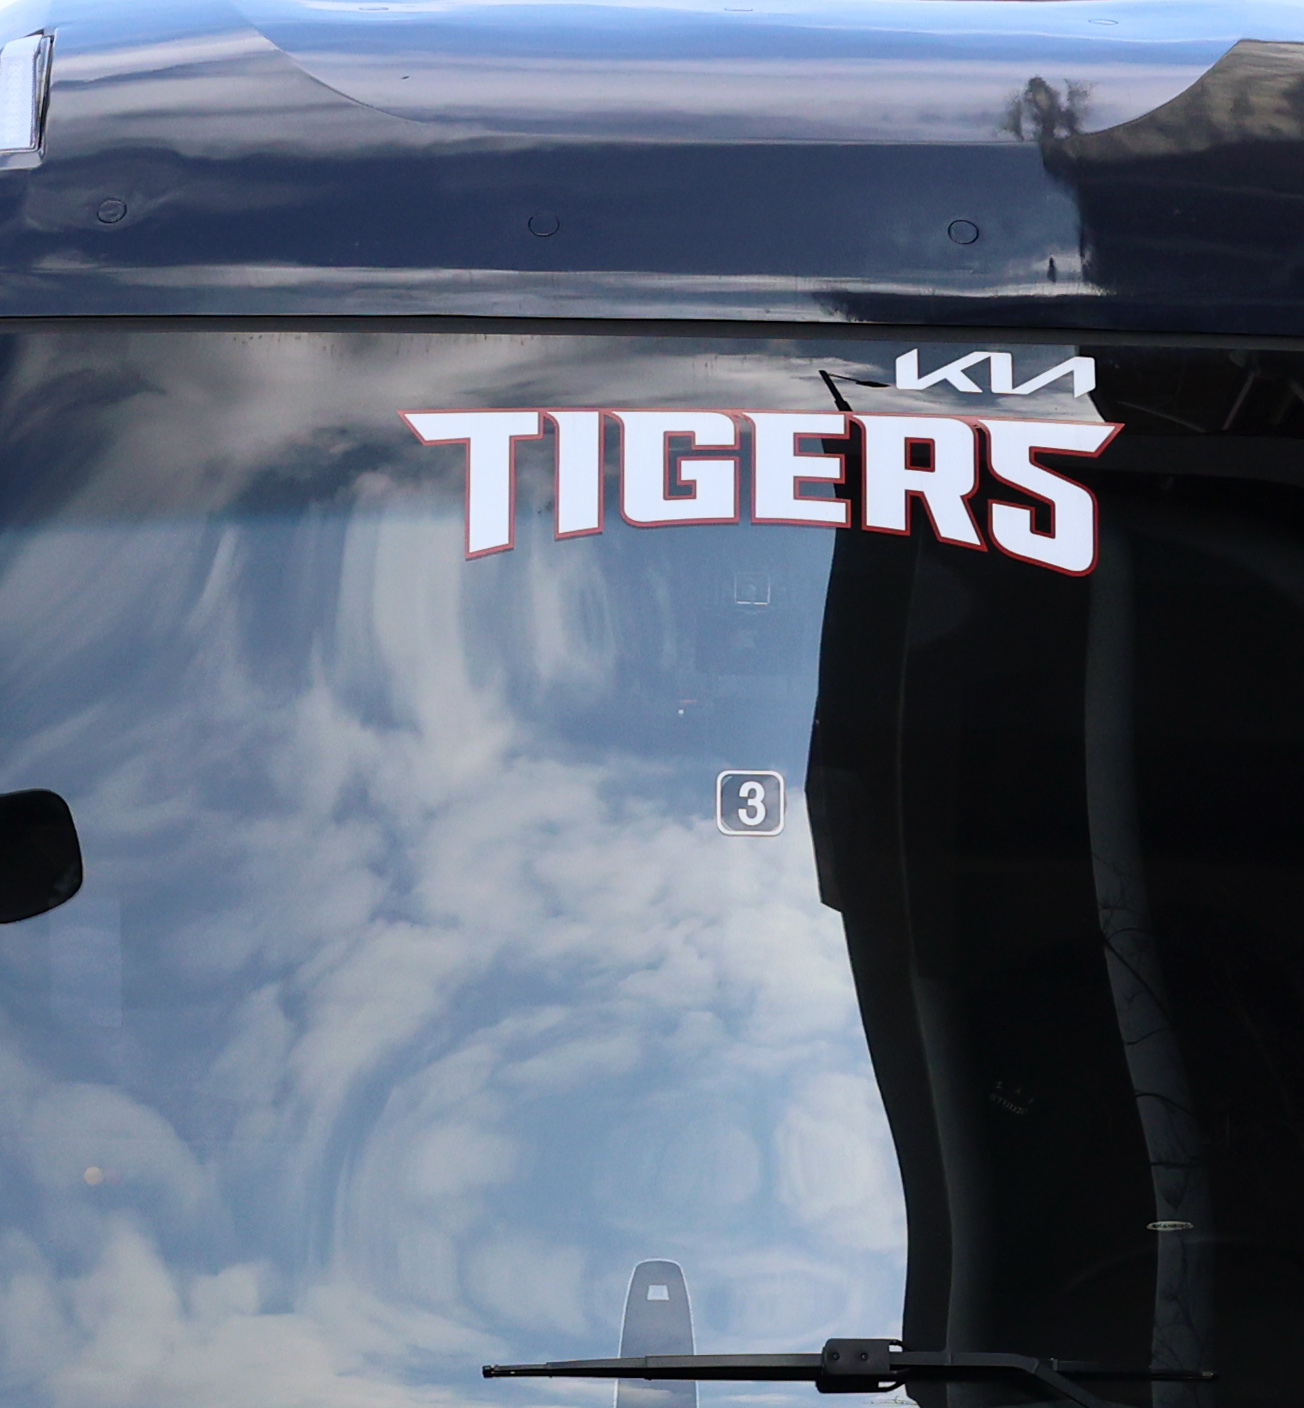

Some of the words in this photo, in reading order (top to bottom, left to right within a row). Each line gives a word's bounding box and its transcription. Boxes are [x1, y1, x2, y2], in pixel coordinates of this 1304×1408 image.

[895, 347, 1097, 399] KIA
[397, 407, 1126, 577] TIGERS
[736, 780, 769, 828] 3
